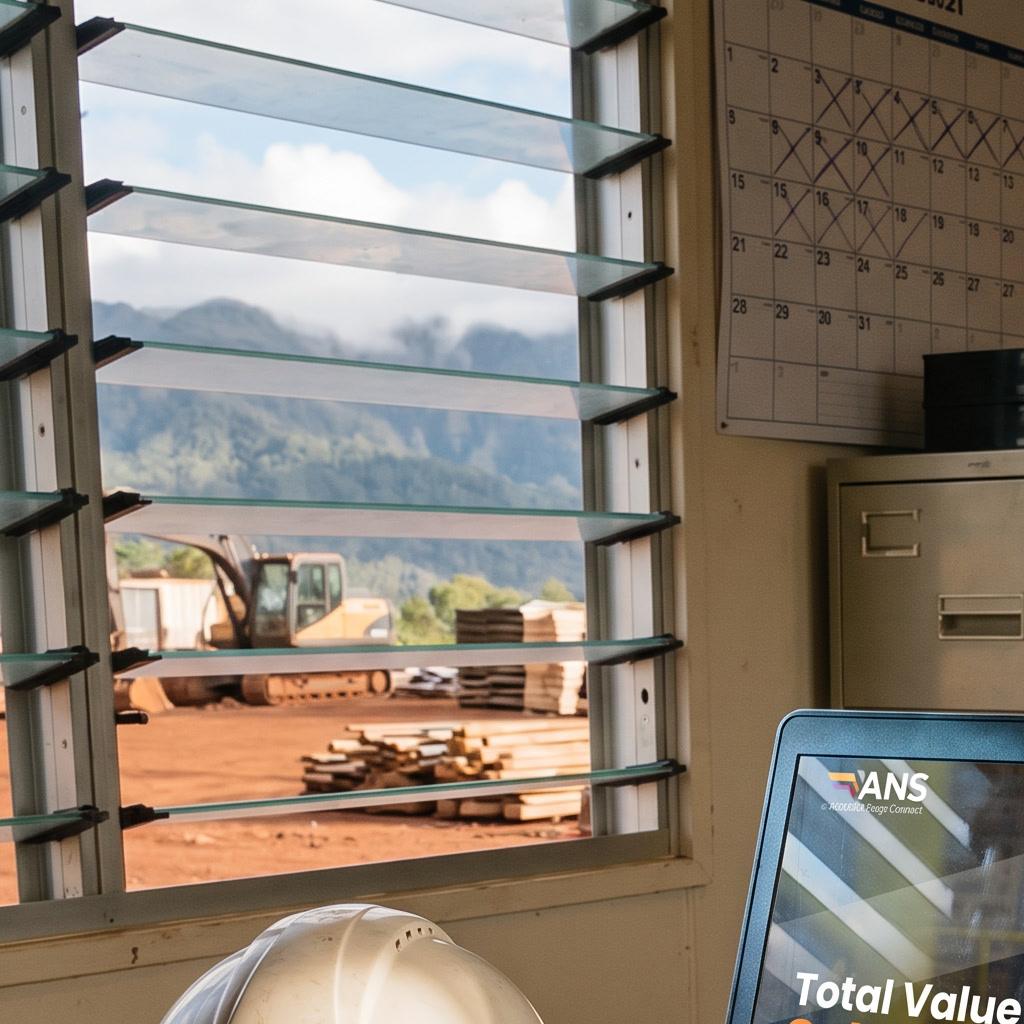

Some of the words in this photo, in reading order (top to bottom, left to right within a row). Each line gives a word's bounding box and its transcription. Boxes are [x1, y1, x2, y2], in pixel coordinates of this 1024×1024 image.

[932, 159, 944, 174] 12
[732, 173, 745, 189] 15
[774, 183, 788, 198] 15
[816, 191, 829, 206] 16
[932, 215, 945, 230] 19
[732, 236, 746, 252] 21
[774, 244, 788, 259] 22
[816, 250, 830, 266] 23
[857, 258, 870, 273] 24
[895, 265, 909, 280] 25
[968, 278, 980, 292] 27
[1002, 284, 1015, 298] 27
[732, 298, 747, 314] 28
[775, 304, 789, 320] 29
[818, 310, 831, 325] 30
[858, 316, 870, 331] 31
[857, 771, 929, 802] ANS
[796, 971, 894, 1015] Total
